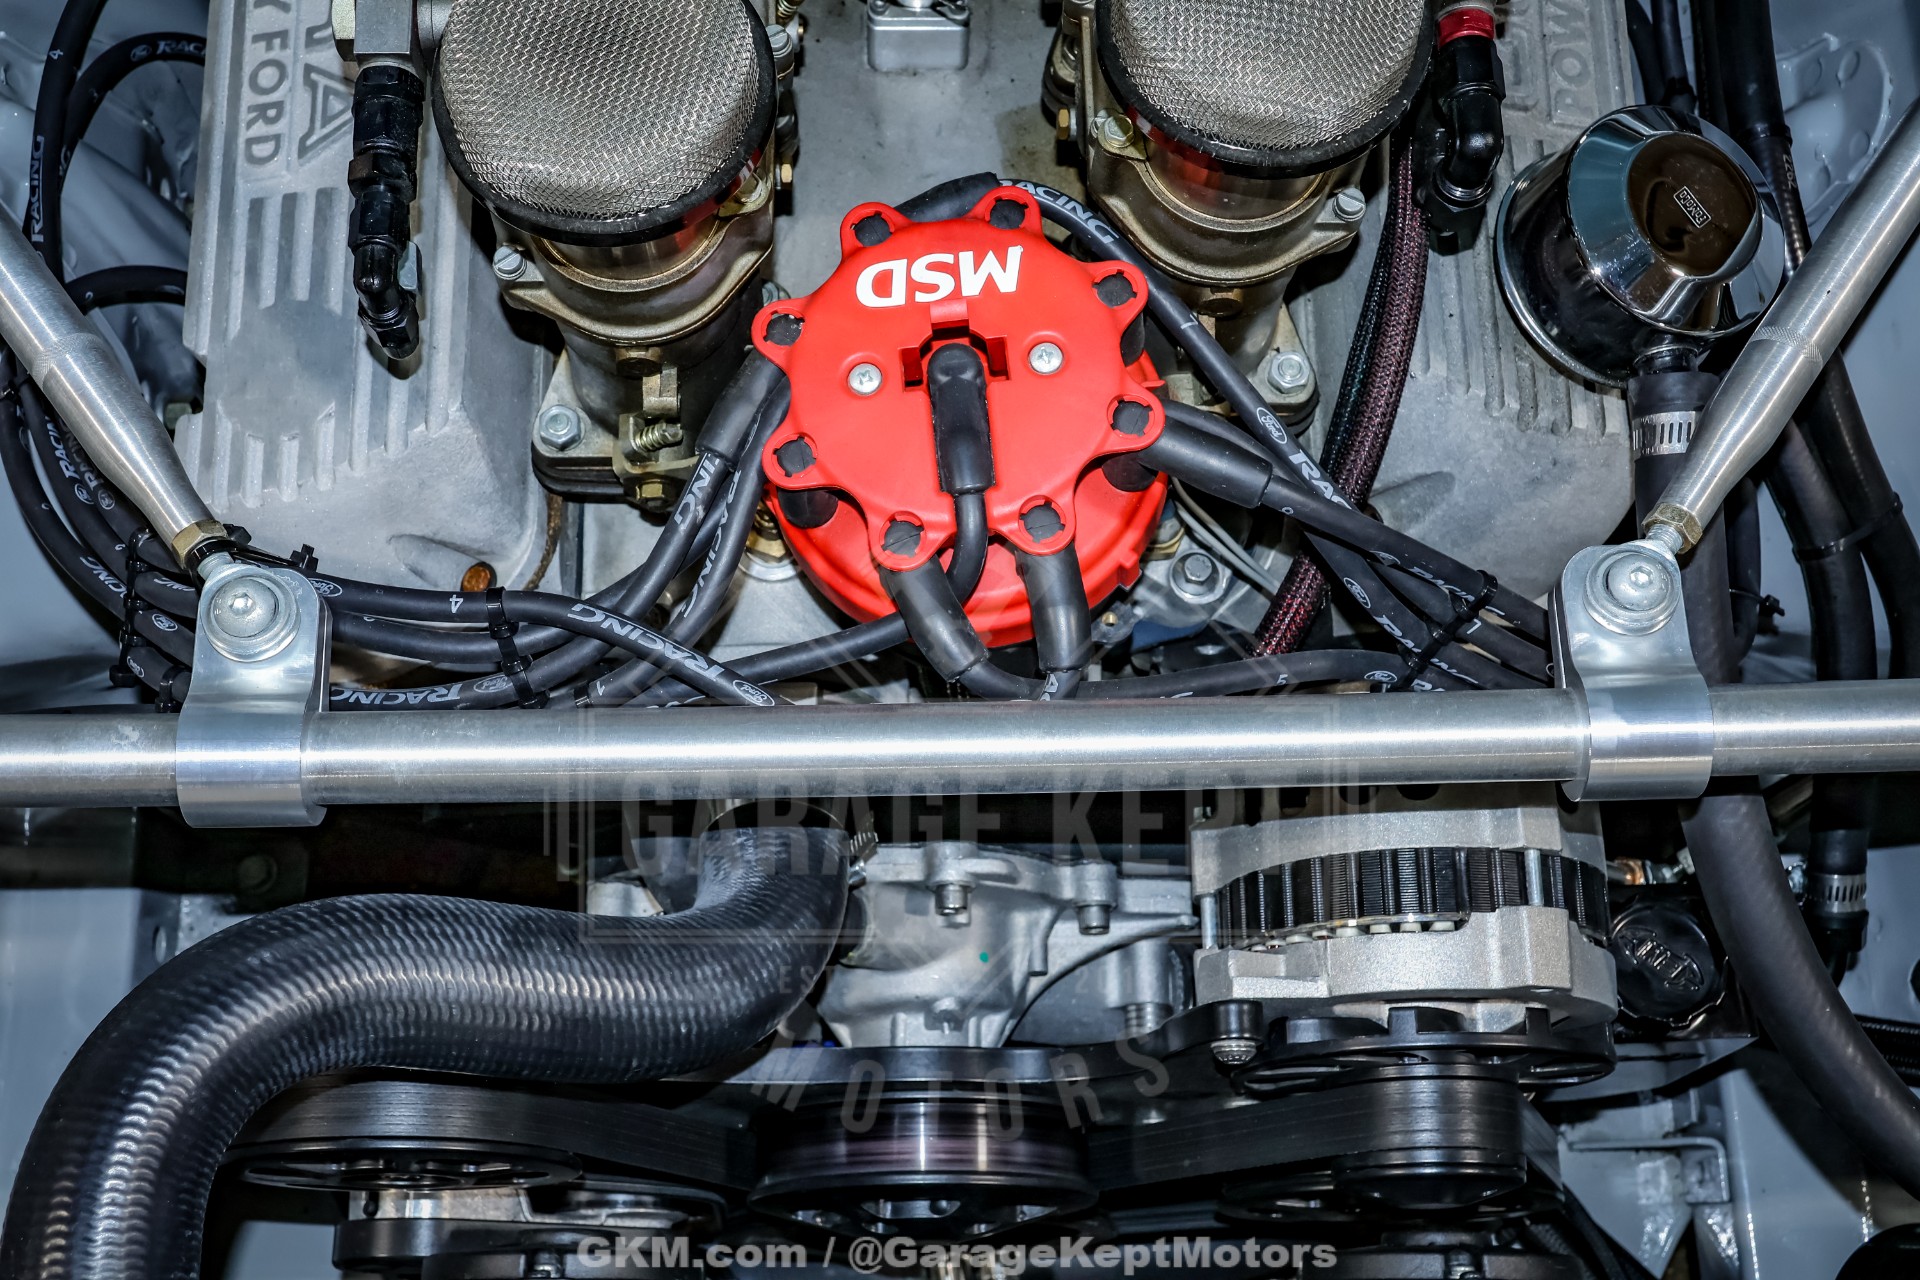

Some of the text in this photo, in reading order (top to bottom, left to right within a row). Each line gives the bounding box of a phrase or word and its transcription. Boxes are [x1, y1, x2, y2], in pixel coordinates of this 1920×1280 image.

[50, 49, 64, 60] 4
[156, 40, 207, 57] RAC
[244, 30, 290, 165] FORD
[30, 135, 45, 243] RACING
[1677, 188, 1708, 226] FoMoCo
[855, 245, 1024, 309] MSD
[673, 452, 721, 531] ING
[1259, 411, 1353, 510] Ford RAC
[680, 469, 742, 618] RACING
[80, 556, 128, 599] CING
[449, 594, 463, 614] 4
[567, 603, 770, 705] RACING Ford
[330, 683, 464, 706] RACING
